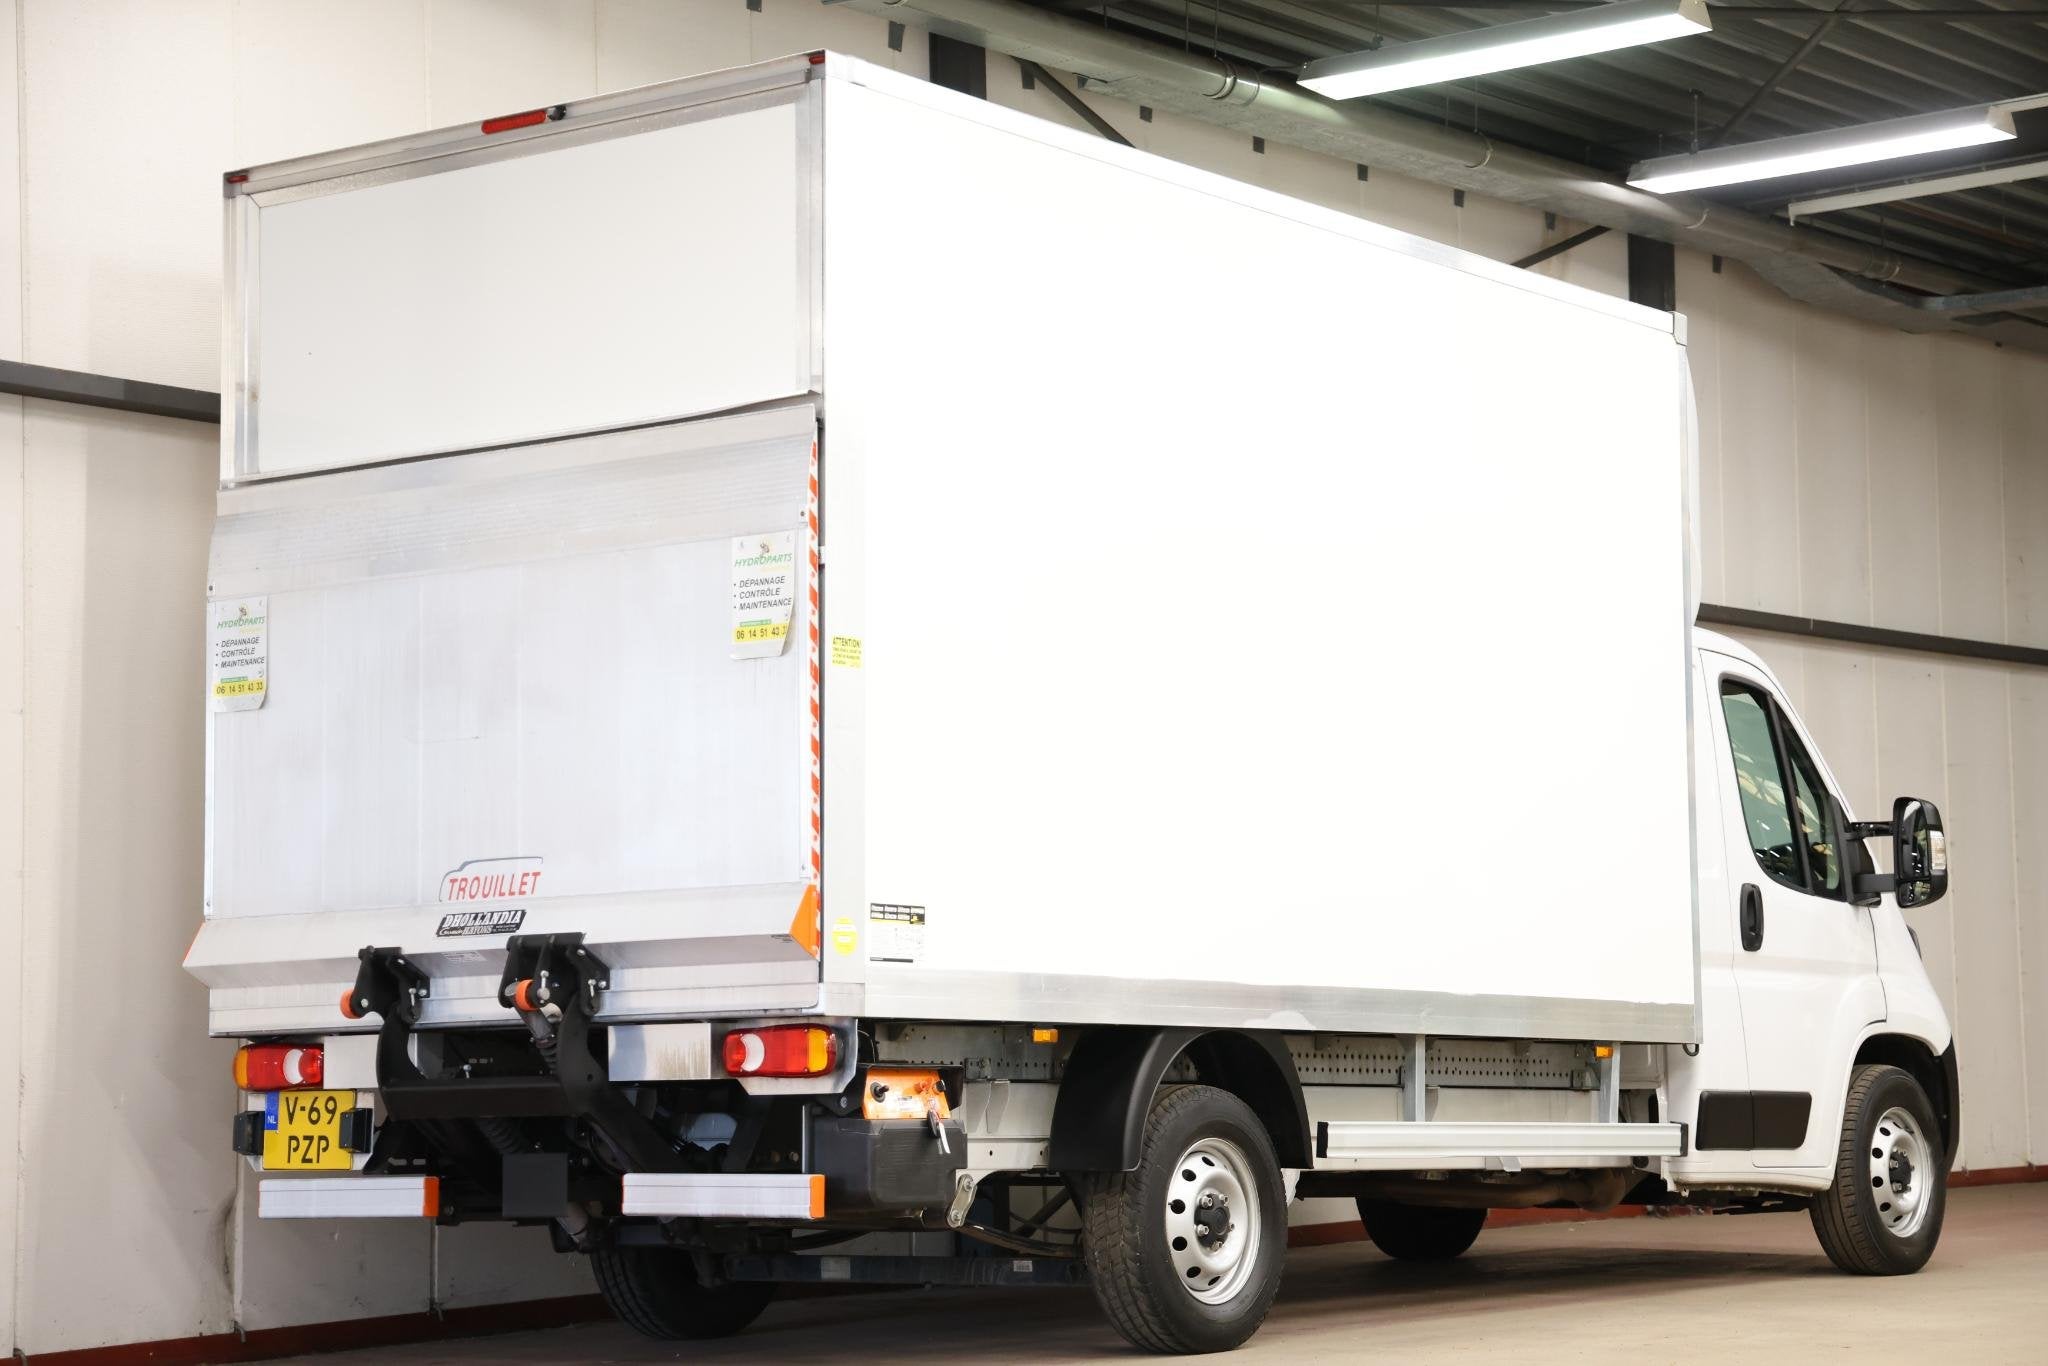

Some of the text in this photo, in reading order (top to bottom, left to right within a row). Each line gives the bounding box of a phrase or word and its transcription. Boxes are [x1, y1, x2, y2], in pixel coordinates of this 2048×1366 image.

[735, 553, 792, 567] HYDROPARTS
[739, 576, 785, 588] DÉPANNAGE
[739, 588, 780, 599] CONTRÔLE
[739, 598, 792, 610] MAINTENANCE
[217, 616, 265, 629] HYDROPARTS
[737, 631, 745, 639] 06
[749, 629, 757, 638] 14
[760, 628, 768, 637] 51
[221, 657, 265, 668] MAINTENANCE
[216, 686, 226, 695] 06
[229, 685, 236, 693] 14
[238, 684, 245, 692] 51
[448, 872, 541, 900] TROUILLET
[442, 911, 522, 927] DHOLLANDIA
[285, 1096, 338, 1125] V-69
[267, 1116, 276, 1124] NL
[287, 1135, 330, 1163] PZP
